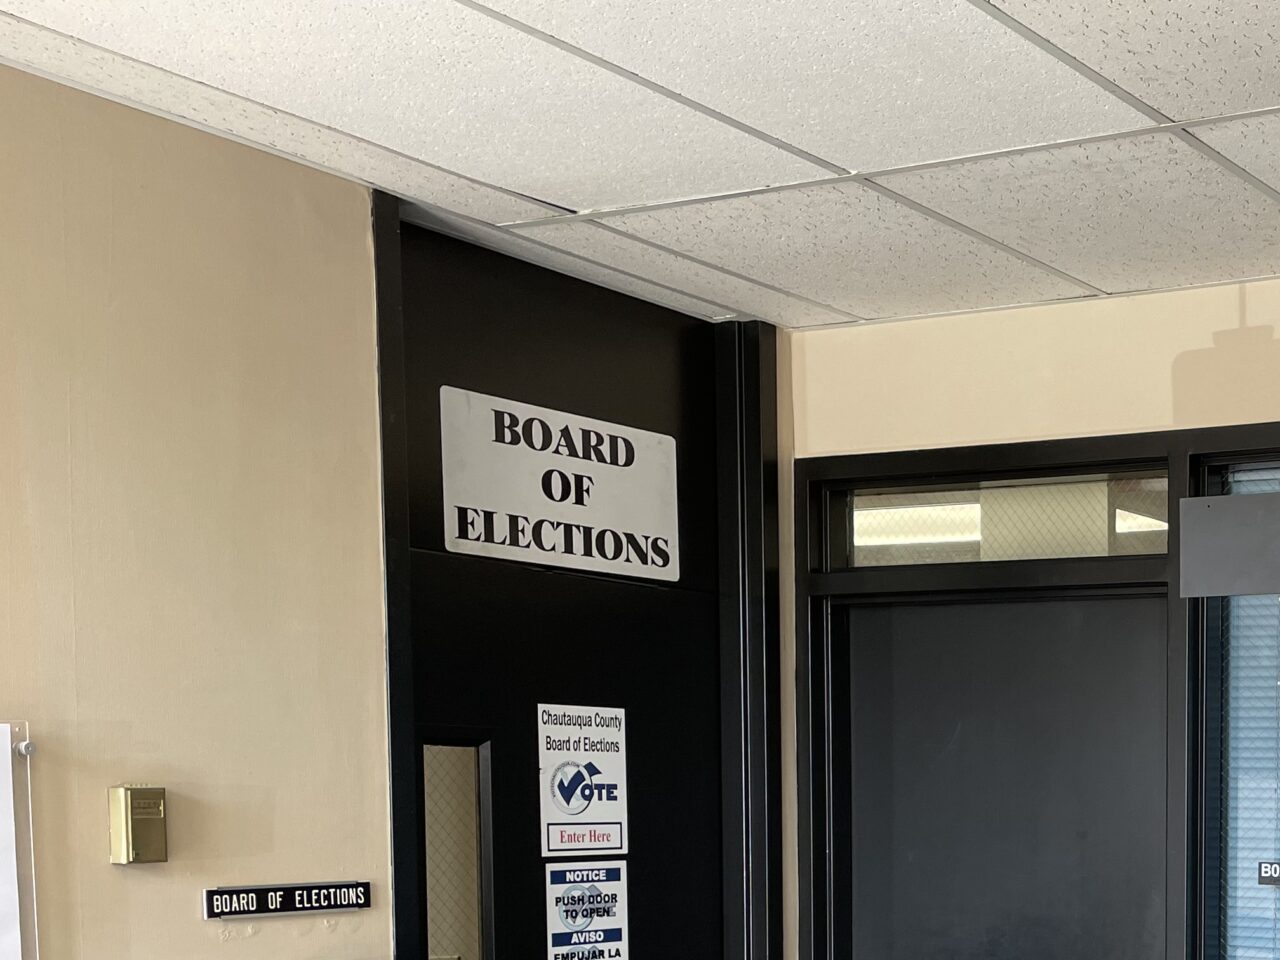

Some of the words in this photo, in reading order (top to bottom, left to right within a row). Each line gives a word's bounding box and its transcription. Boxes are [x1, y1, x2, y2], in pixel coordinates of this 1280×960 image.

[491, 409, 635, 467] BOARD
[541, 469, 594, 506] OF
[454, 505, 670, 568] ELECTIONS
[541, 710, 592, 730] Chautauqua
[594, 712, 622, 732] County
[545, 735, 571, 751] Board
[573, 737, 581, 751] of
[583, 737, 620, 752] Elections
[560, 830, 586, 844] Enter
[589, 829, 611, 843] Here
[565, 870, 607, 882] NOTICE
[213, 892, 257, 913] BOARD
[268, 891, 283, 910] OF
[295, 887, 365, 908] ELECTIONS
[555, 895, 585, 906] PUSH
[588, 893, 618, 904] DOOR
[563, 909, 578, 919] TO
[581, 906, 610, 918] OPEN
[571, 931, 604, 944] AVISO
[608, 948, 622, 959] LA
